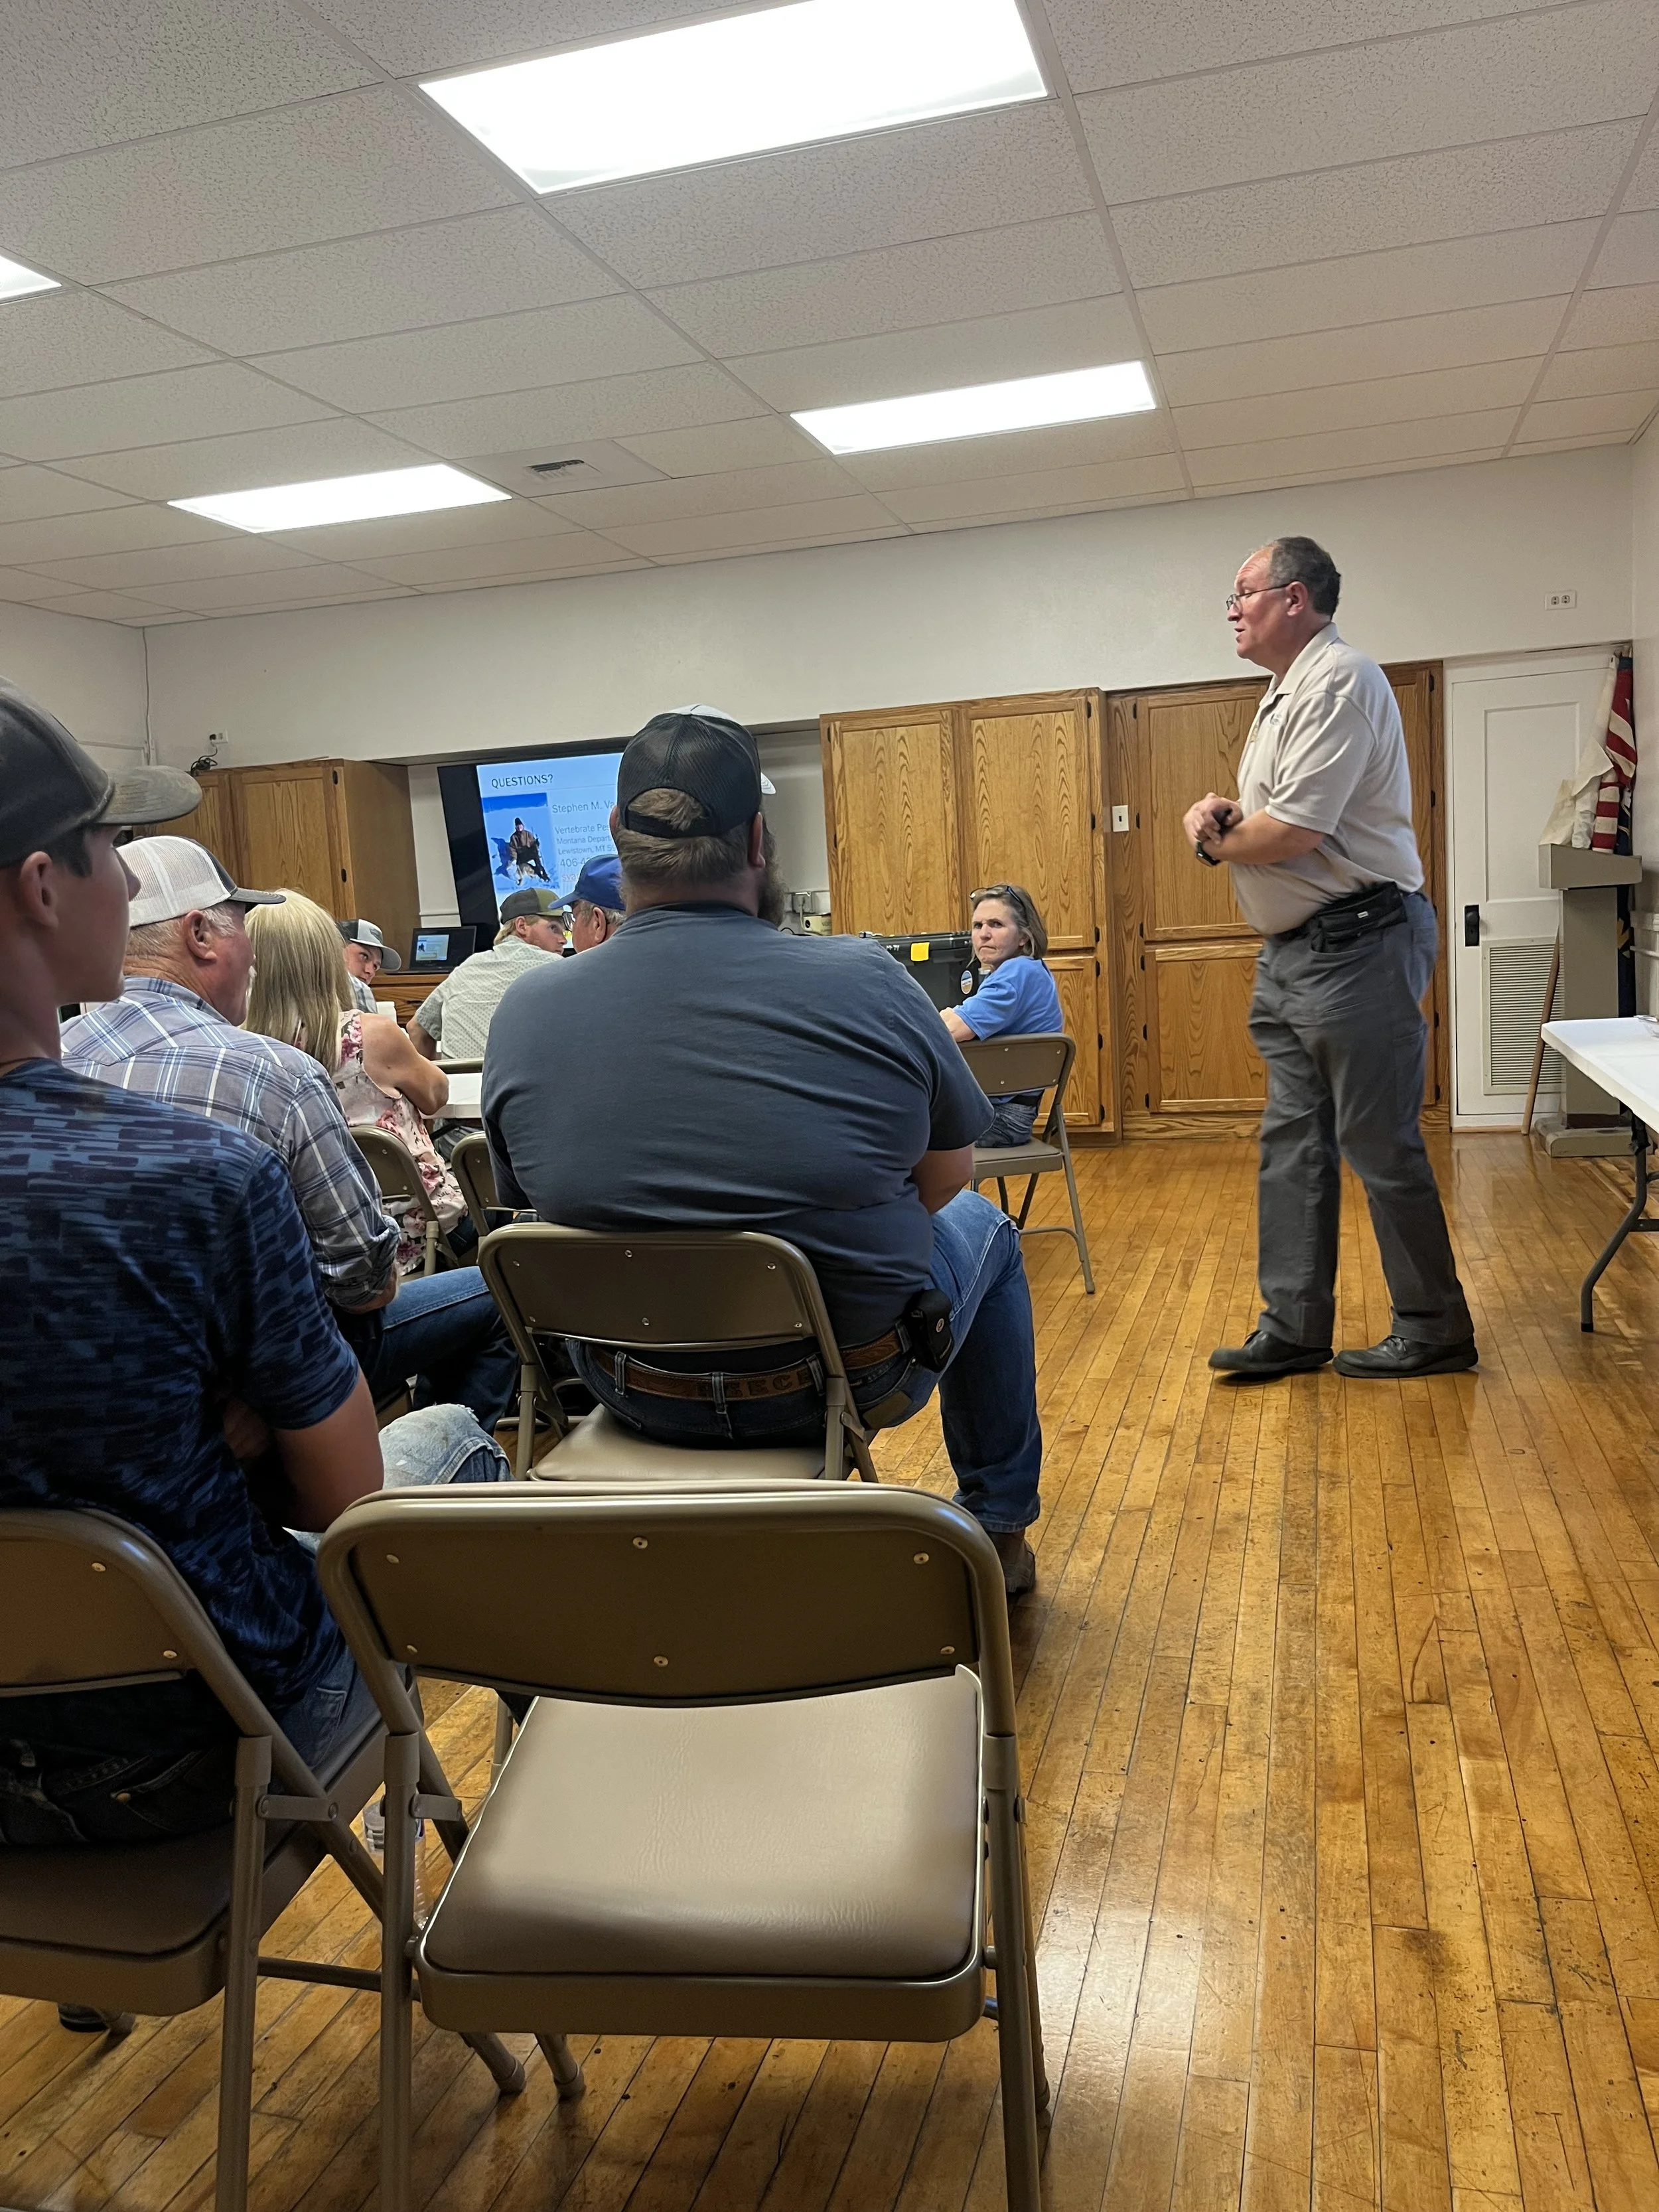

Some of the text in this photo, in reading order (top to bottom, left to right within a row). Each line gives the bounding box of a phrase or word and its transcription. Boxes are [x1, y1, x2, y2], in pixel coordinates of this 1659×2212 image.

[491, 774, 553, 789] QUESTIONS?
[552, 803, 589, 814] Stephen
[591, 801, 602, 810] M.
[555, 825, 595, 834] Vertebrate
[560, 857, 591, 867] 406-4
